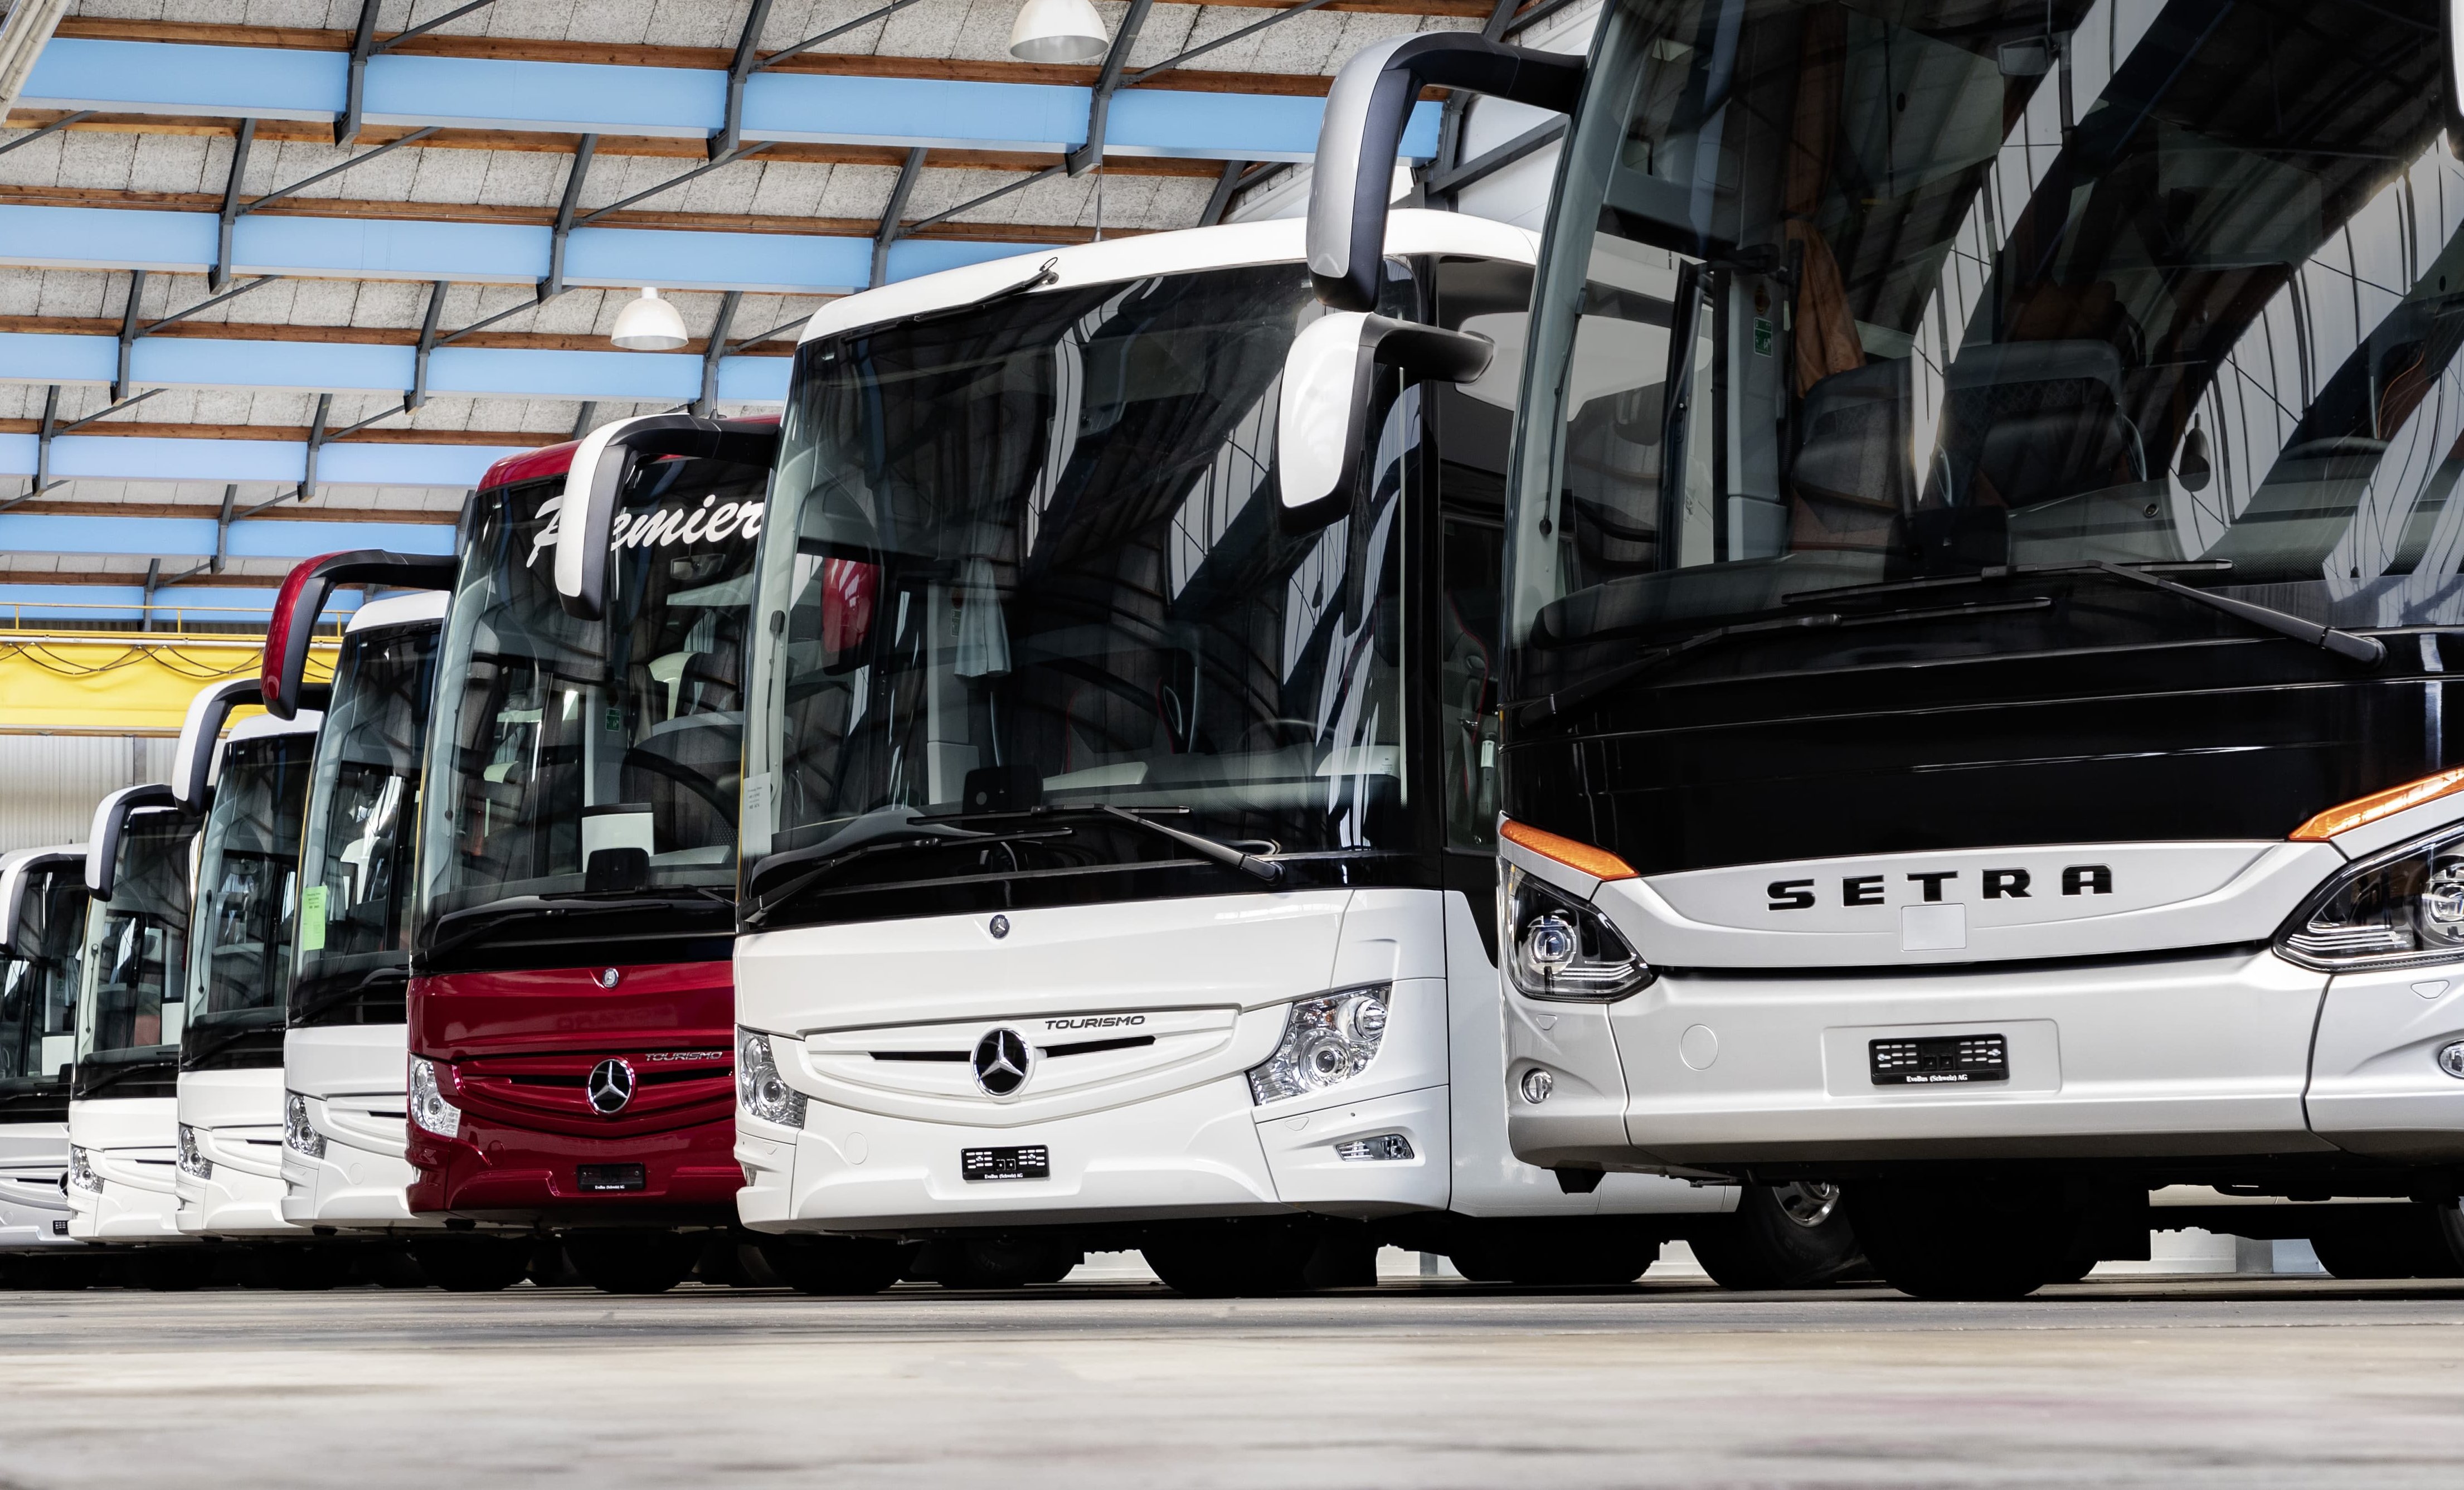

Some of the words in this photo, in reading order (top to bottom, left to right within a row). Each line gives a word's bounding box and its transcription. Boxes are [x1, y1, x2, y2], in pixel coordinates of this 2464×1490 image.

[526, 494, 764, 567] Pemier
[1767, 863, 2113, 911] SETRA
[1045, 1015, 1145, 1030] TOURISMO
[645, 1051, 723, 1061] TOURISMO
[1930, 1074, 1957, 1083] (Schweiz)
